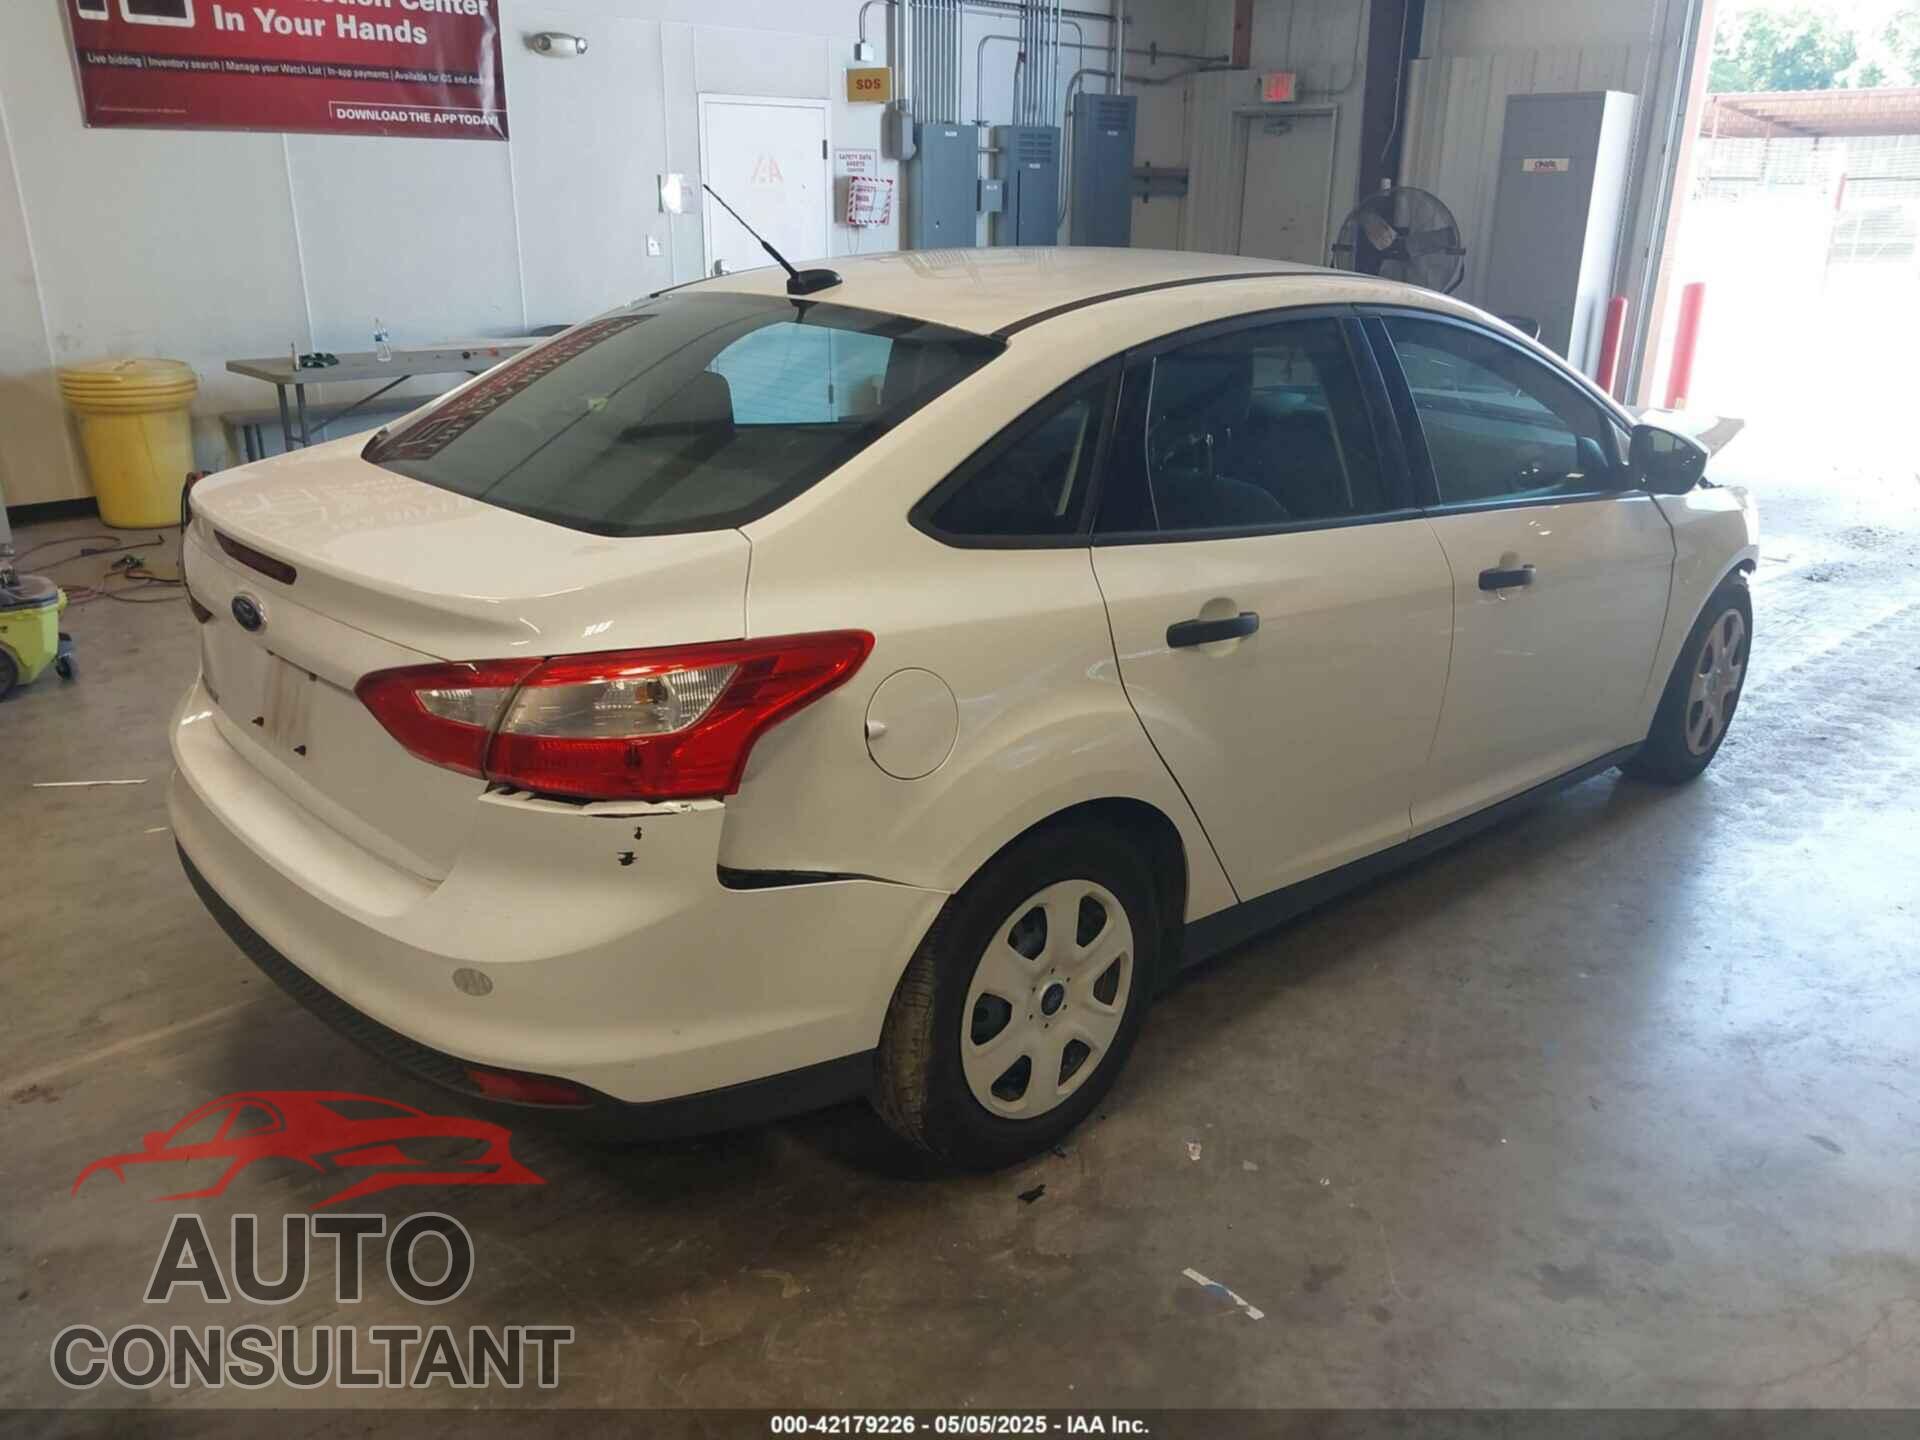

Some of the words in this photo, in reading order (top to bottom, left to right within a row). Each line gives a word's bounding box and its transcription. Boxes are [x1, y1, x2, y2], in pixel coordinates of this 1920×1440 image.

[212, 4, 245, 32] In
[252, 7, 326, 38] Your
[335, 14, 428, 45] Hands
[87, 52, 106, 64] Live
[108, 54, 142, 68] bidding
[148, 56, 189, 70] Inventory
[191, 60, 219, 70] search
[225, 60, 259, 74] Manage
[261, 63, 279, 74] your
[280, 63, 306, 75] Watch
[308, 65, 321, 76] List
[354, 69, 389, 80] payments
[395, 71, 427, 82] Available
[856, 78, 881, 90] SDS
[336, 108, 408, 122] DOWNLOAD
[408, 111, 431, 124] THE
[434, 112, 457, 124] APP
